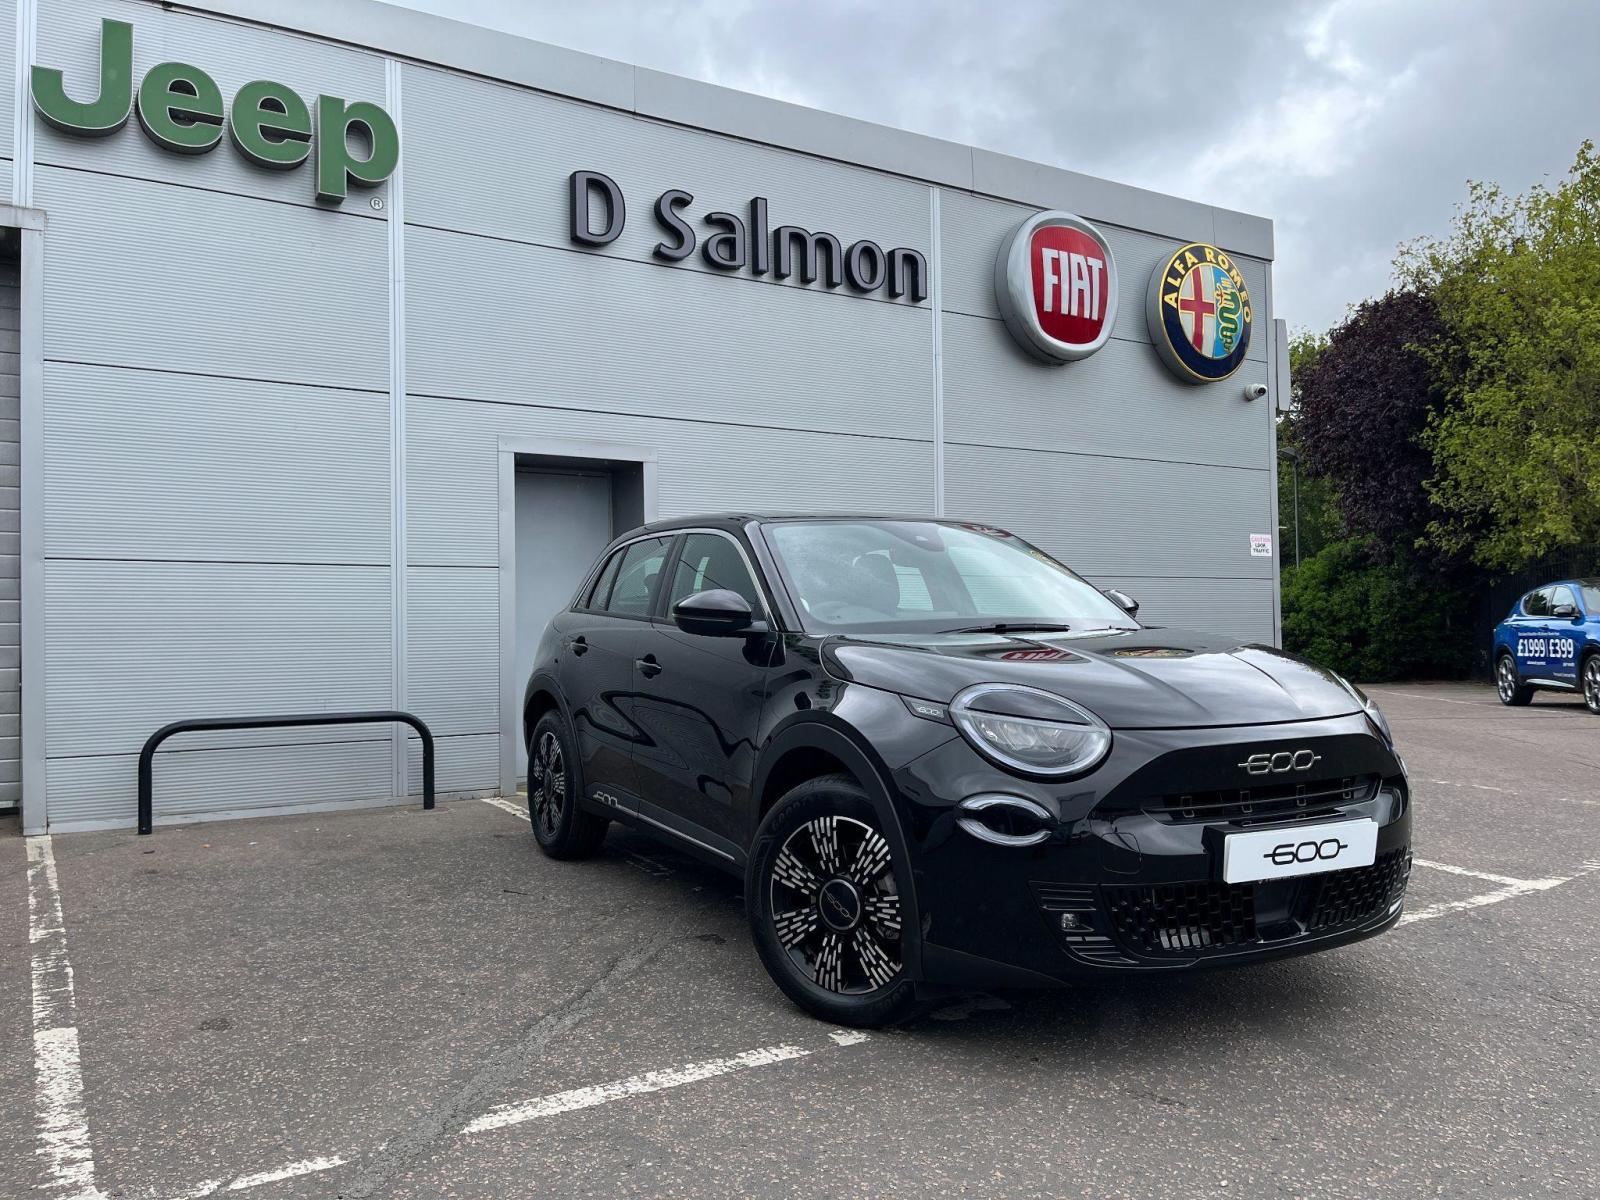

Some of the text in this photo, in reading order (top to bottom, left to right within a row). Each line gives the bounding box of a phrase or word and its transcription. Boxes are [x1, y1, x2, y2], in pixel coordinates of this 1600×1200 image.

[30, 17, 400, 204] Jeep
[569, 170, 928, 303] D Salmon
[1041, 247, 1103, 321] FIAT
[1163, 247, 1251, 324] ALFA ROMEO
[1517, 638, 1574, 659] £1999 £399
[1246, 750, 1316, 776] 600
[1271, 838, 1341, 866] 600
